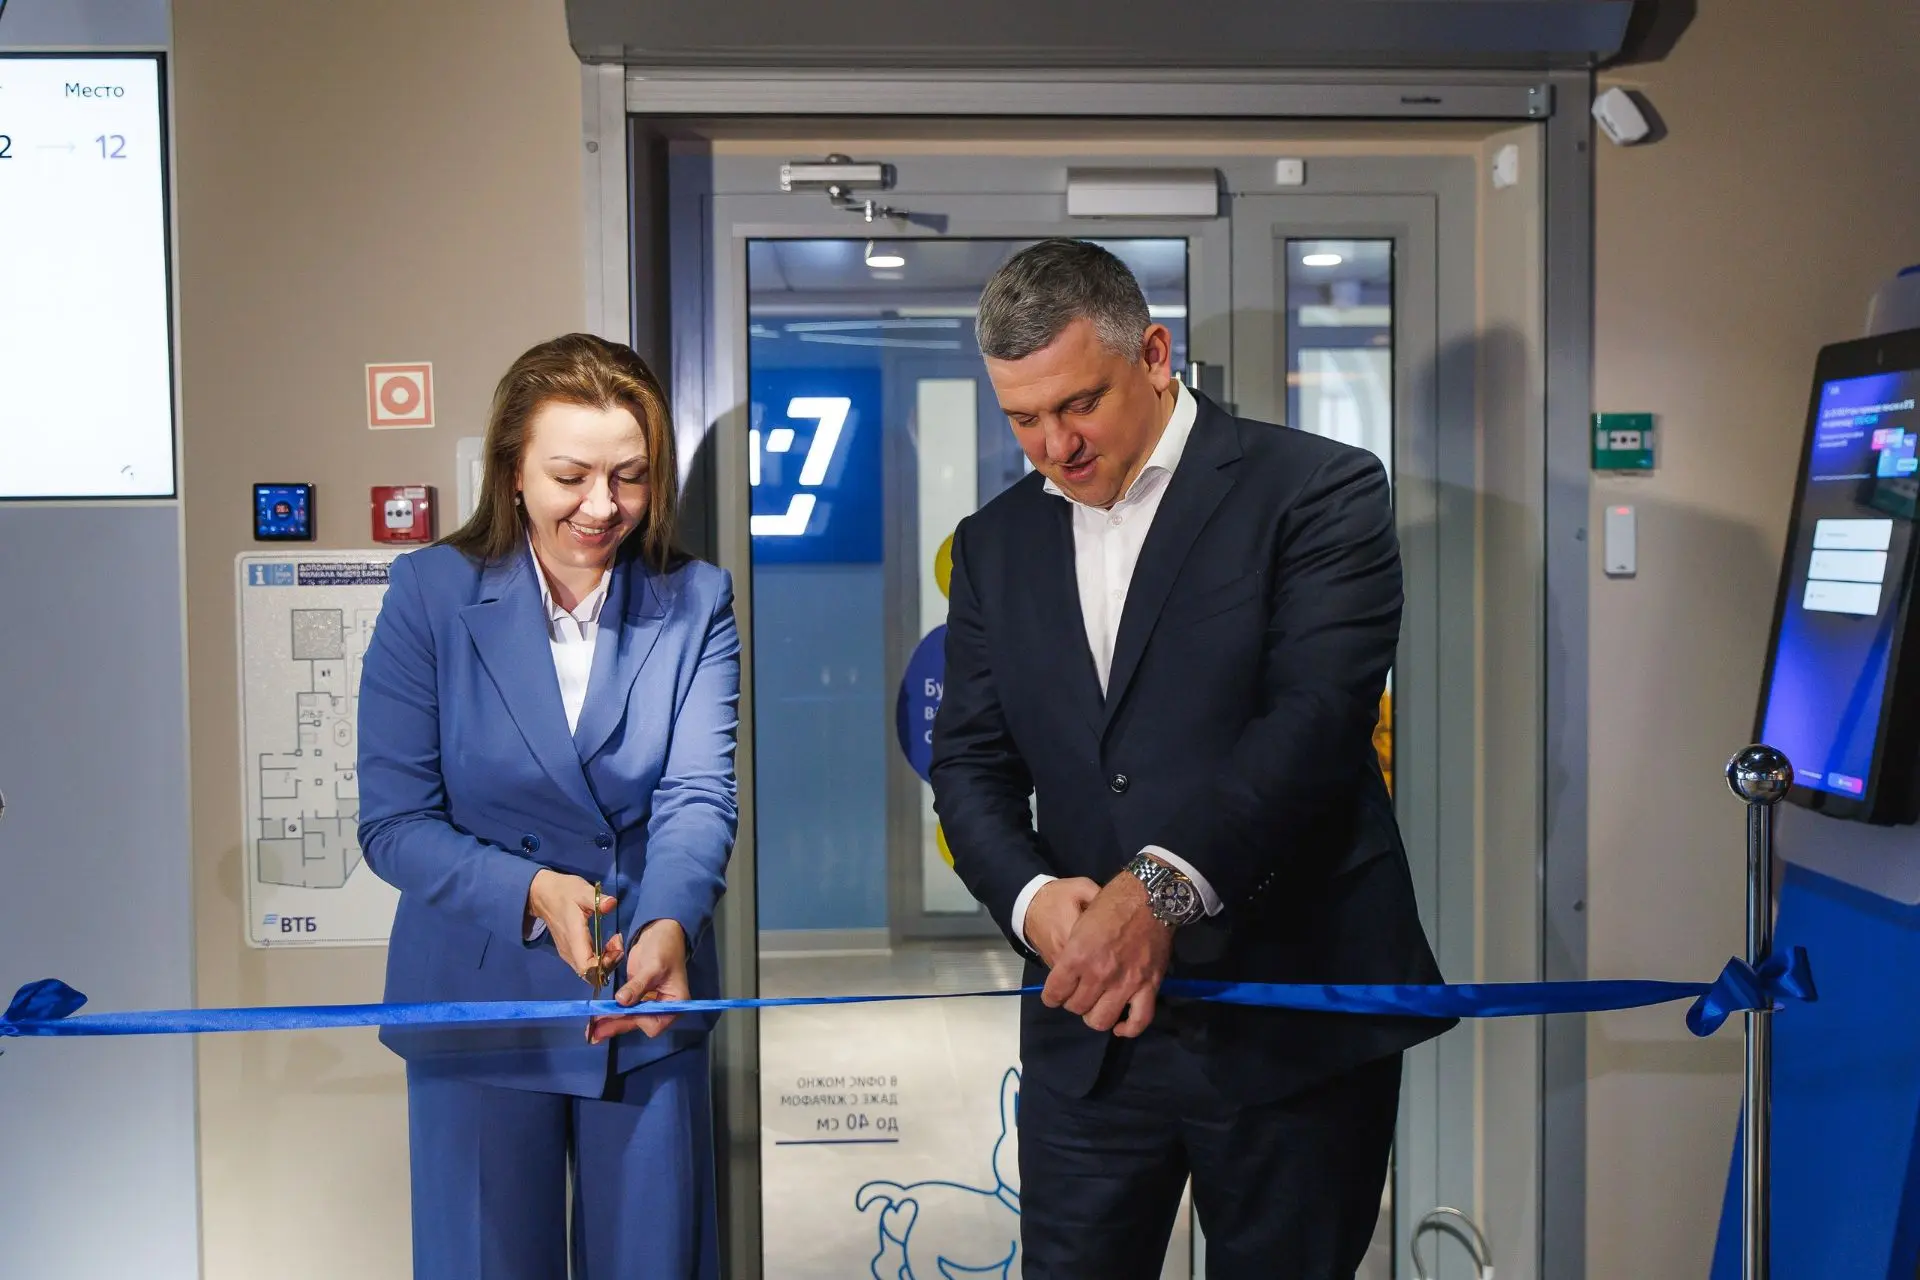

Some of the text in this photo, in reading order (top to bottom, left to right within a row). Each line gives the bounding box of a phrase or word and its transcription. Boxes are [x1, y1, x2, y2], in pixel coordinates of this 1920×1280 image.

[65, 82, 125, 98] Место
[95, 134, 127, 159] 12
[281, 917, 317, 933] ВТБ
